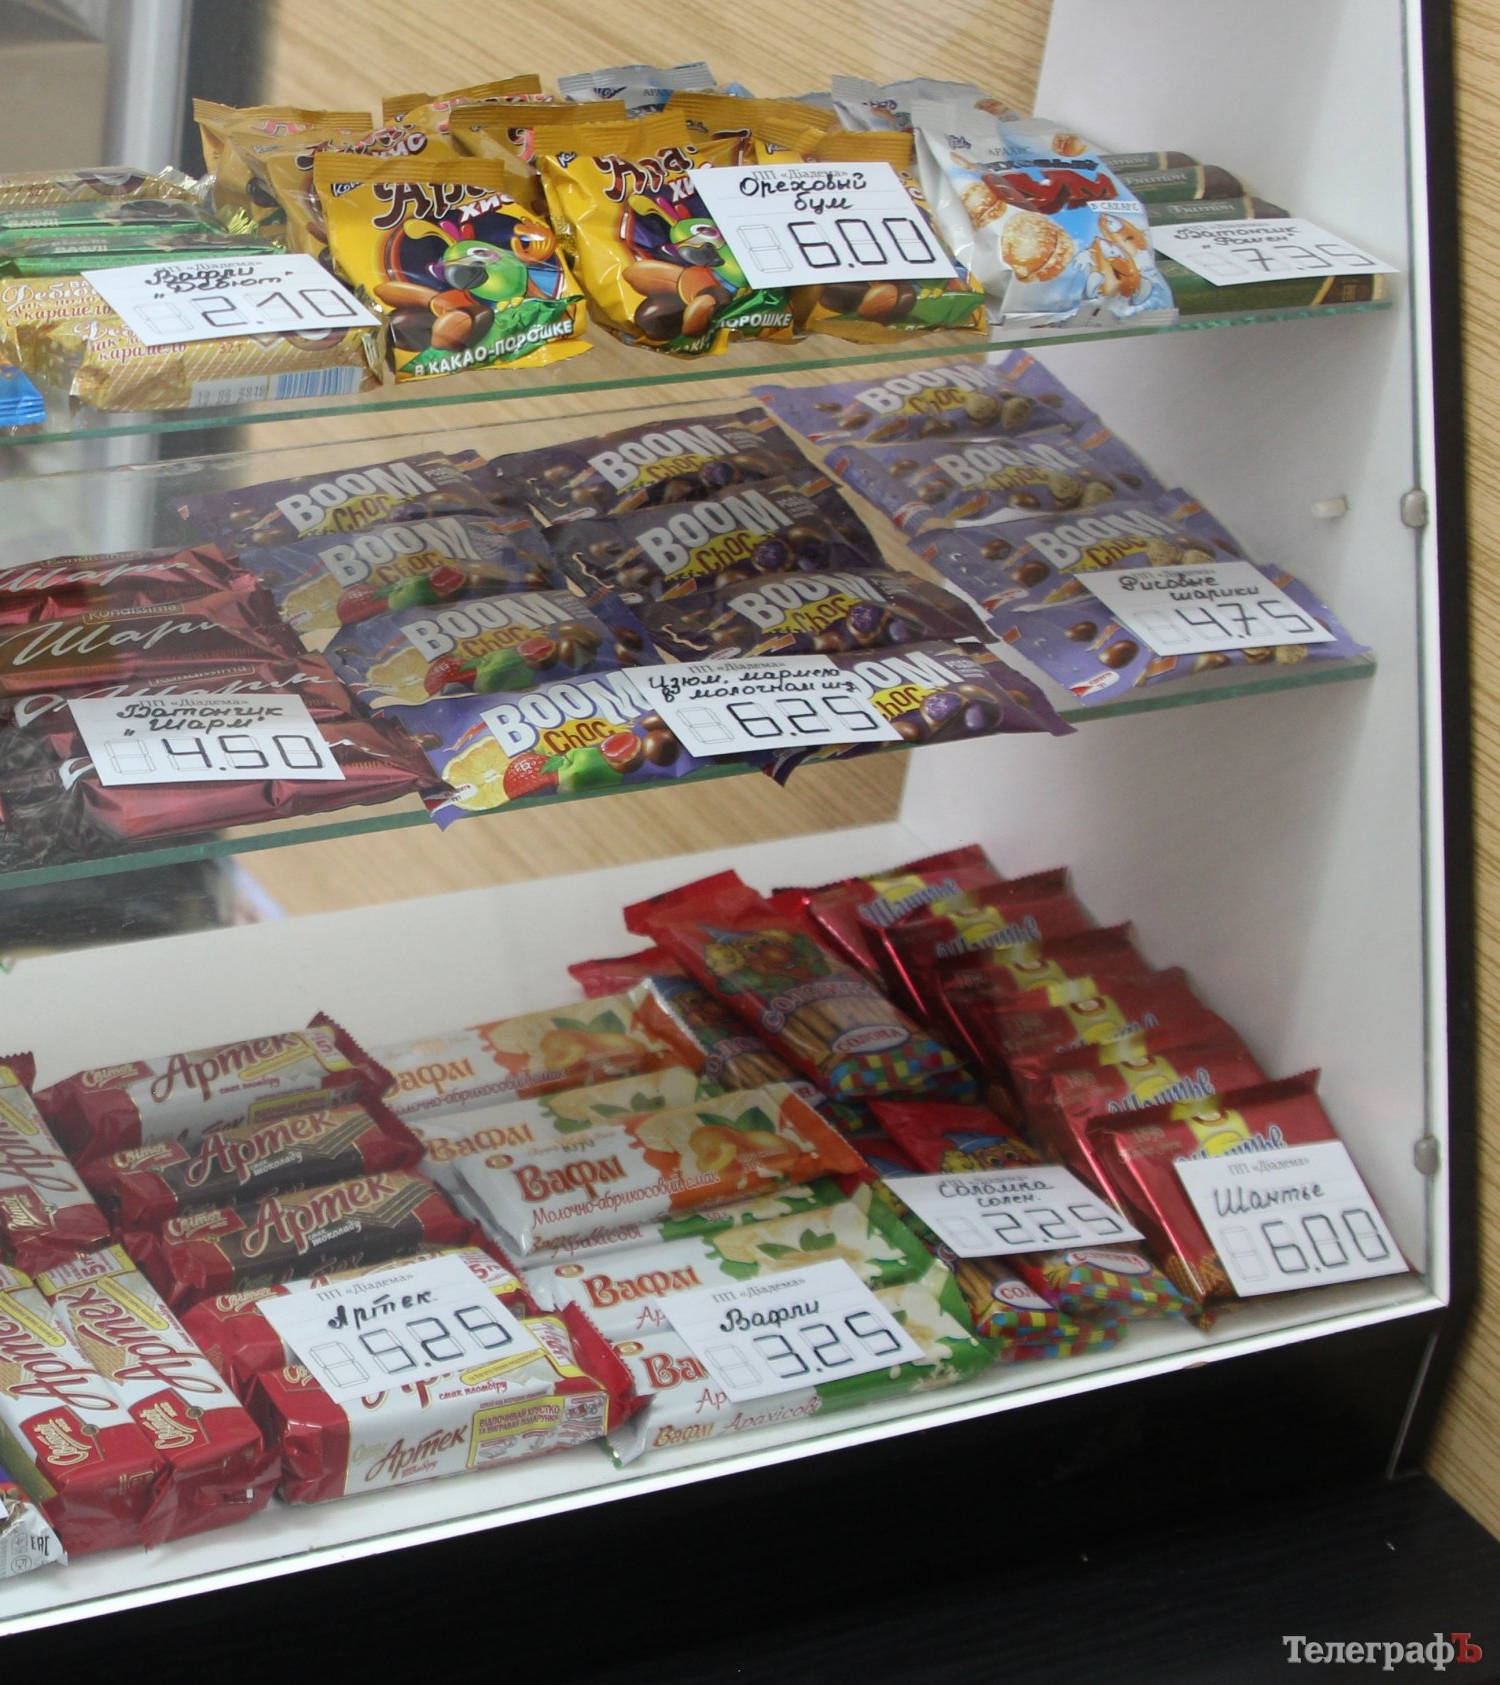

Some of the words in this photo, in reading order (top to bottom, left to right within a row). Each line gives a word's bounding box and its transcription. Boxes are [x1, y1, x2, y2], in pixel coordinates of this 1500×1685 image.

[739, 173, 868, 198] Ореховый
[780, 166, 849, 182] «Діадема»
[794, 195, 854, 213] бум
[788, 217, 936, 269] 6.00
[1231, 243, 1376, 273] 7.35
[24, 304, 116, 324] карамель
[191, 288, 358, 328] 2.10
[100, 343, 188, 364] карамель
[414, 364, 426, 377] В
[429, 319, 574, 376] КАКАО-ПОРОШКЕ
[855, 364, 1000, 415] BOOM
[588, 424, 739, 490] BOOM
[934, 443, 1083, 488] BOOM
[276, 461, 438, 533] BOOM
[317, 517, 482, 587] BOOM
[636, 489, 794, 576] BOOM
[1023, 508, 1183, 571] BOOM
[728, 571, 888, 631] BOOM
[1169, 586, 1260, 602] шарики
[401, 593, 574, 663] BOOM
[1175, 600, 1315, 639] 4.75
[717, 660, 786, 674] «Діадема»
[479, 669, 670, 758] BOOM
[726, 695, 880, 738] 6.25
[161, 734, 325, 772] 4.50
[151, 1031, 301, 1103] Артек
[184, 1110, 339, 1187] Артек
[1228, 1162, 1250, 1177] ПП
[1252, 1156, 1311, 1175] «Діадема»
[512, 1153, 629, 1204] Вафлі
[531, 1170, 684, 1229] Молочно-абрикосовий
[686, 1169, 721, 1190] смак
[938, 1177, 1054, 1197] Соломка
[1212, 1182, 1326, 1218] Шантье
[241, 1173, 399, 1259] Артек
[983, 1203, 1124, 1245] 2.25
[1261, 1207, 1390, 1275] 6.00
[318, 1290, 343, 1303] ПП
[346, 1272, 415, 1299] «Діадема»
[327, 1289, 440, 1330] Артек
[583, 1263, 704, 1310] Вафлі
[711, 1291, 737, 1304] ПП
[739, 1276, 807, 1300] «Діадема»
[719, 1298, 821, 1333] Вафли
[57, 1286, 224, 1395] Артек
[357, 1304, 514, 1375] 5.25
[752, 1310, 902, 1380] 3.25
[438, 1389, 463, 1401] смак
[464, 1380, 508, 1395] пломбіру
[364, 1424, 468, 1483] Артек
